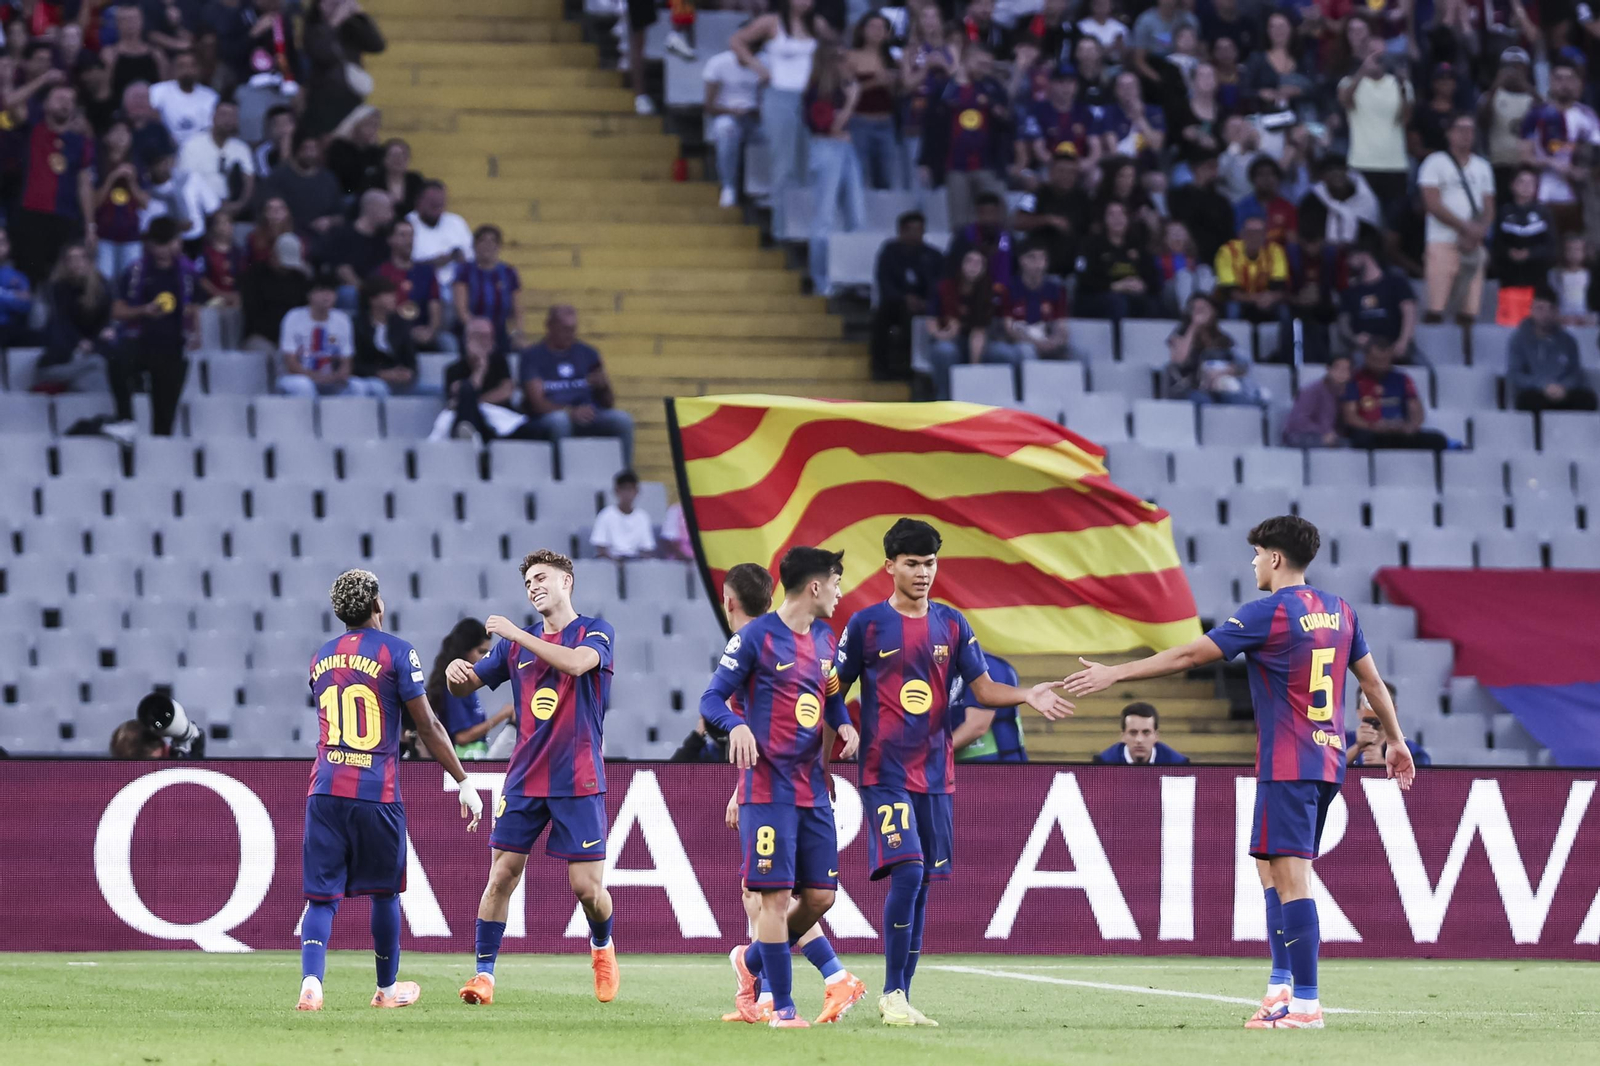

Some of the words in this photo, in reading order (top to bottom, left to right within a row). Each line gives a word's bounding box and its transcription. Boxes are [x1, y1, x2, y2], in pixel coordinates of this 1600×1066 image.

[348, 654, 382, 679] YAMAL
[1307, 647, 1336, 722] 5
[319, 683, 382, 751] 10
[756, 825, 776, 857] 8
[877, 802, 910, 835] 27
[984, 770, 1600, 945] AIRW
